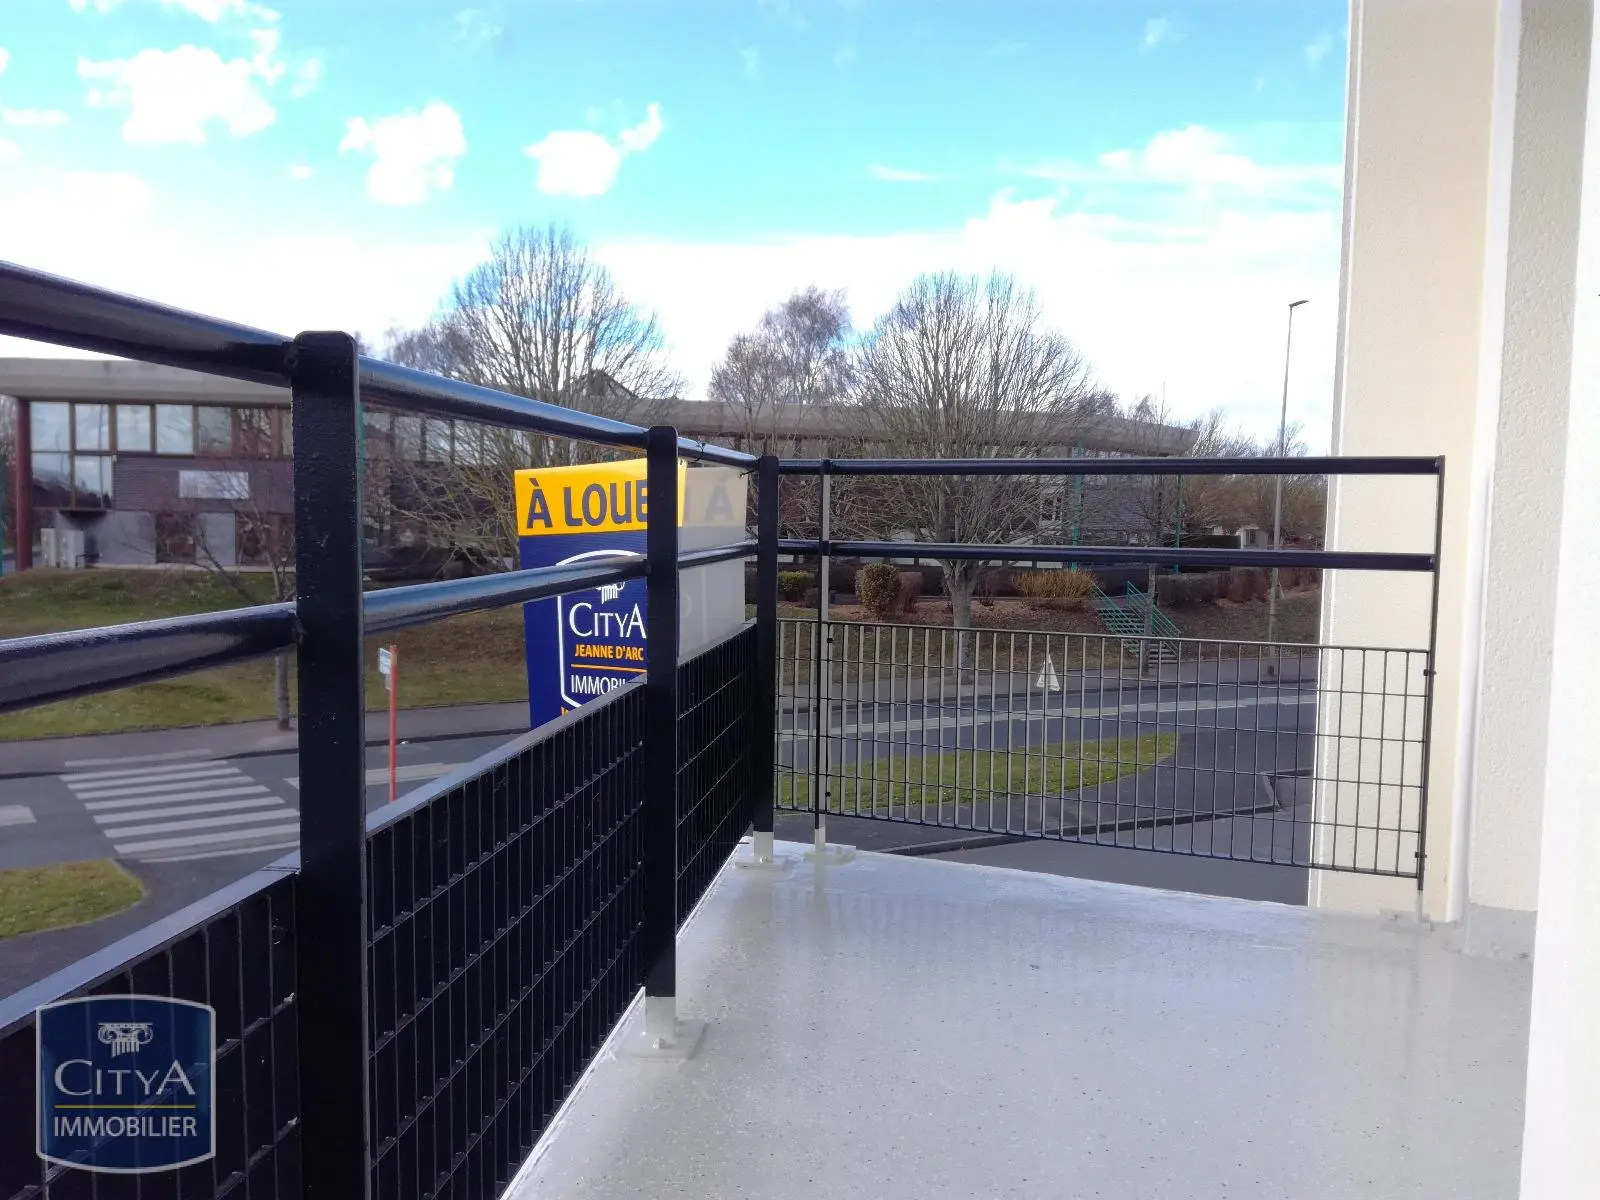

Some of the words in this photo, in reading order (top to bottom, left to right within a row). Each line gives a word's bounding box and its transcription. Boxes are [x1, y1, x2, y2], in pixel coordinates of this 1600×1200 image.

[526, 477, 553, 529] À
[575, 644, 614, 659] JEANNE
[615, 645, 644, 661] D'ARC
